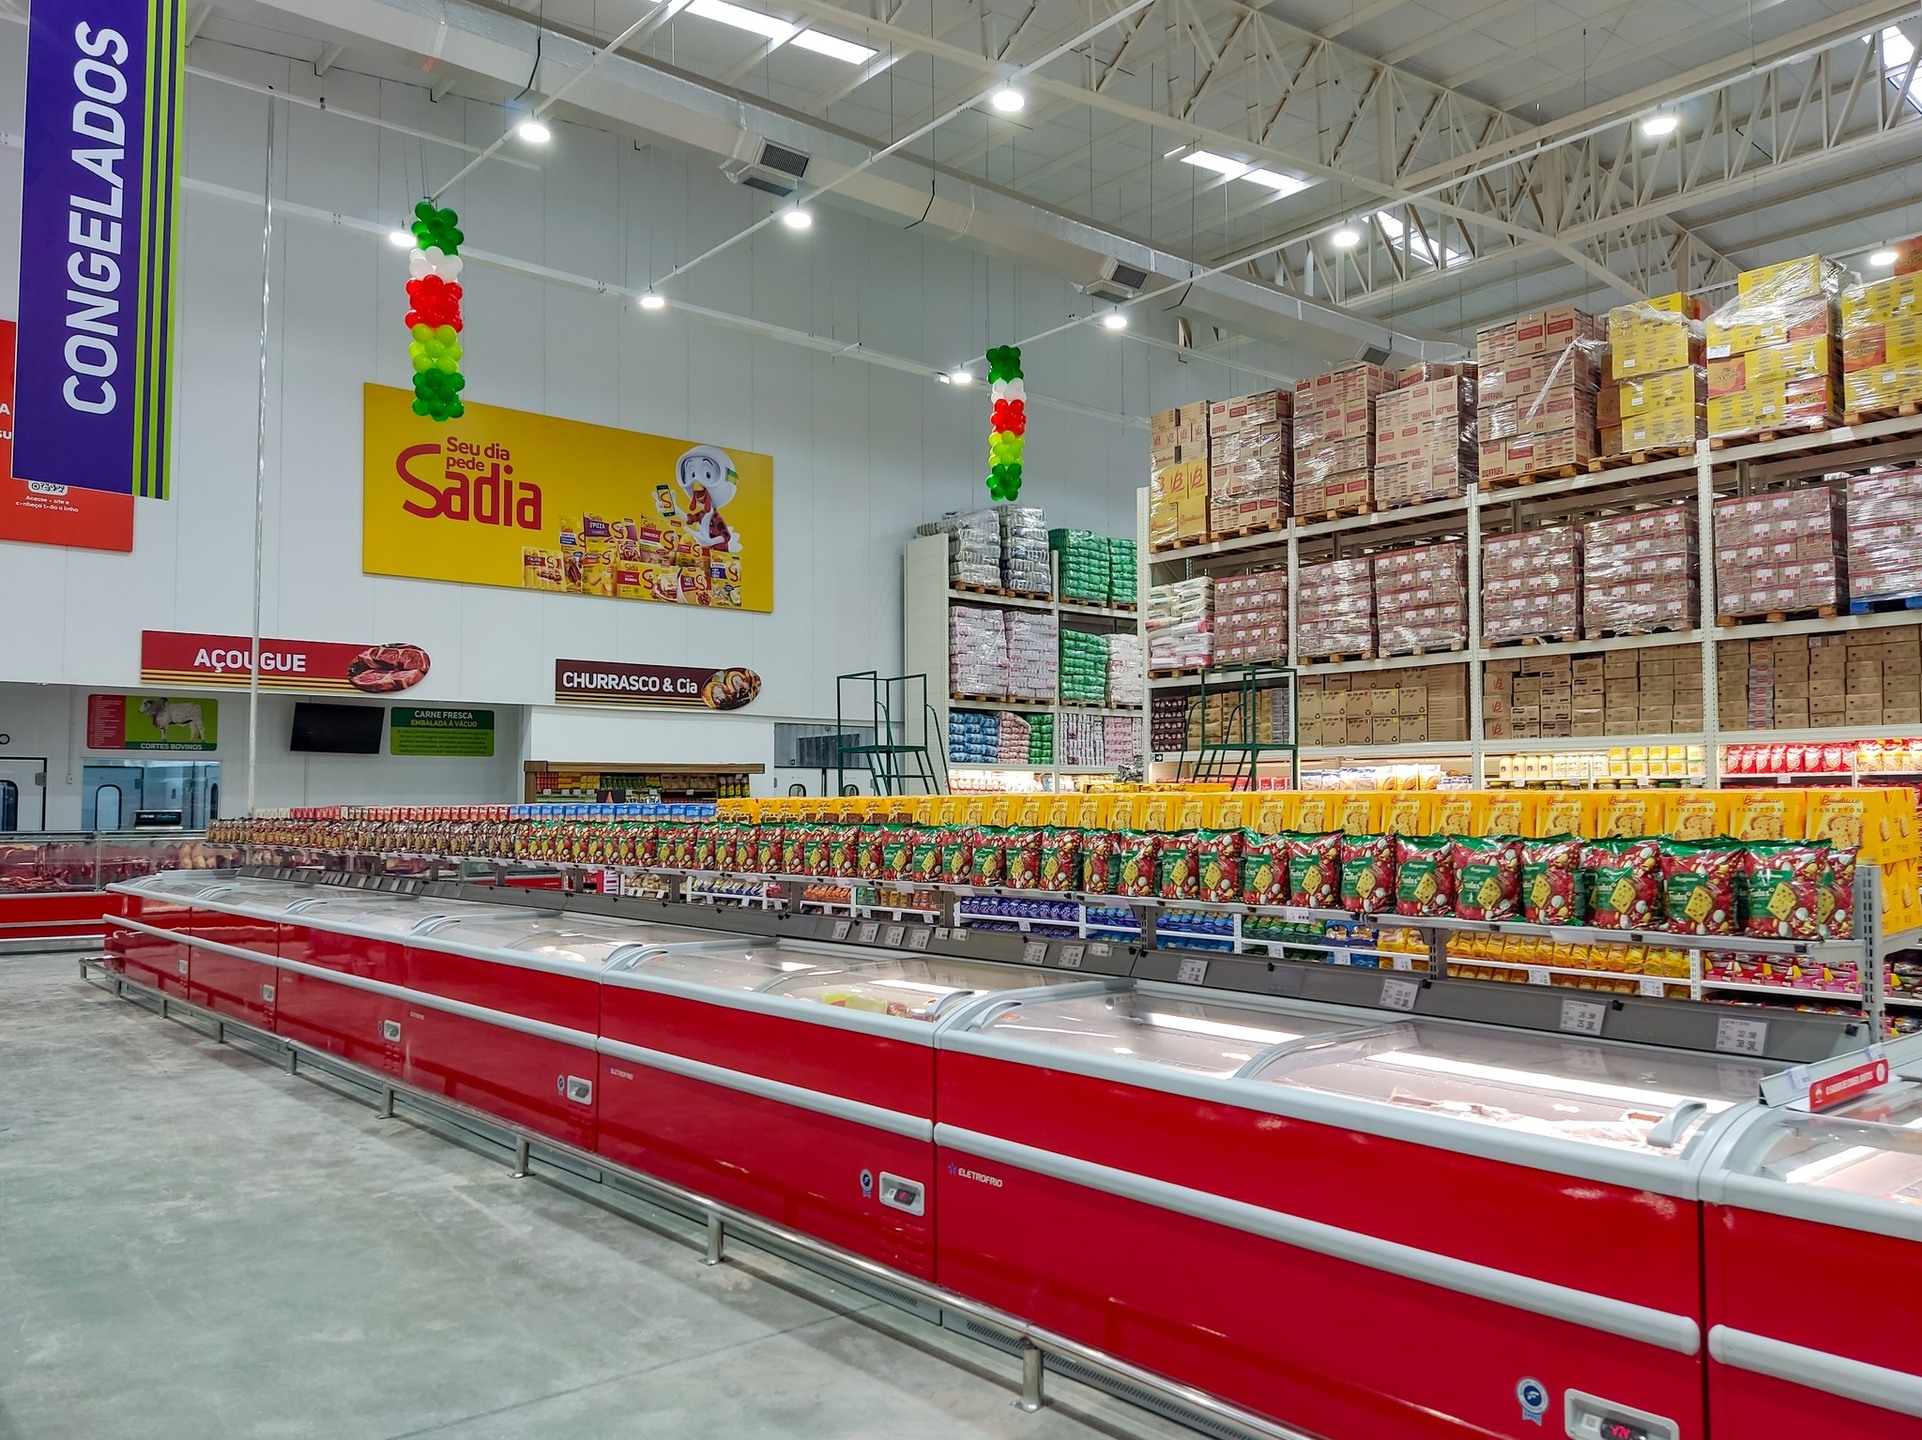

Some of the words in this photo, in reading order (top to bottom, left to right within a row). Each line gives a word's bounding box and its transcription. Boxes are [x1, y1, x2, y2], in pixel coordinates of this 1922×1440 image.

[62, 20, 129, 415] CONGELADOS
[446, 436, 480, 456] Seu
[483, 442, 511, 462] dia
[446, 456, 485, 473] pede
[396, 443, 542, 531] Sadia
[193, 647, 307, 673] AÇOUGUE
[562, 671, 660, 692] CHURRASCO
[662, 679, 674, 693] &
[676, 678, 698, 695] Cia
[414, 710, 442, 719] CARNE
[442, 711, 473, 719] FRESCA
[410, 719, 448, 728] EMBALADA
[140, 742, 169, 750] CORTES
[170, 743, 203, 751] BOVINOS
[1609, 796, 1642, 806] Bauducco
[1677, 796, 1712, 806] Bauducco
[1743, 795, 1780, 805] Bauducco
[1820, 795, 1861, 805] Bauducco
[957, 1167, 1003, 1188] ELETROFRIO
